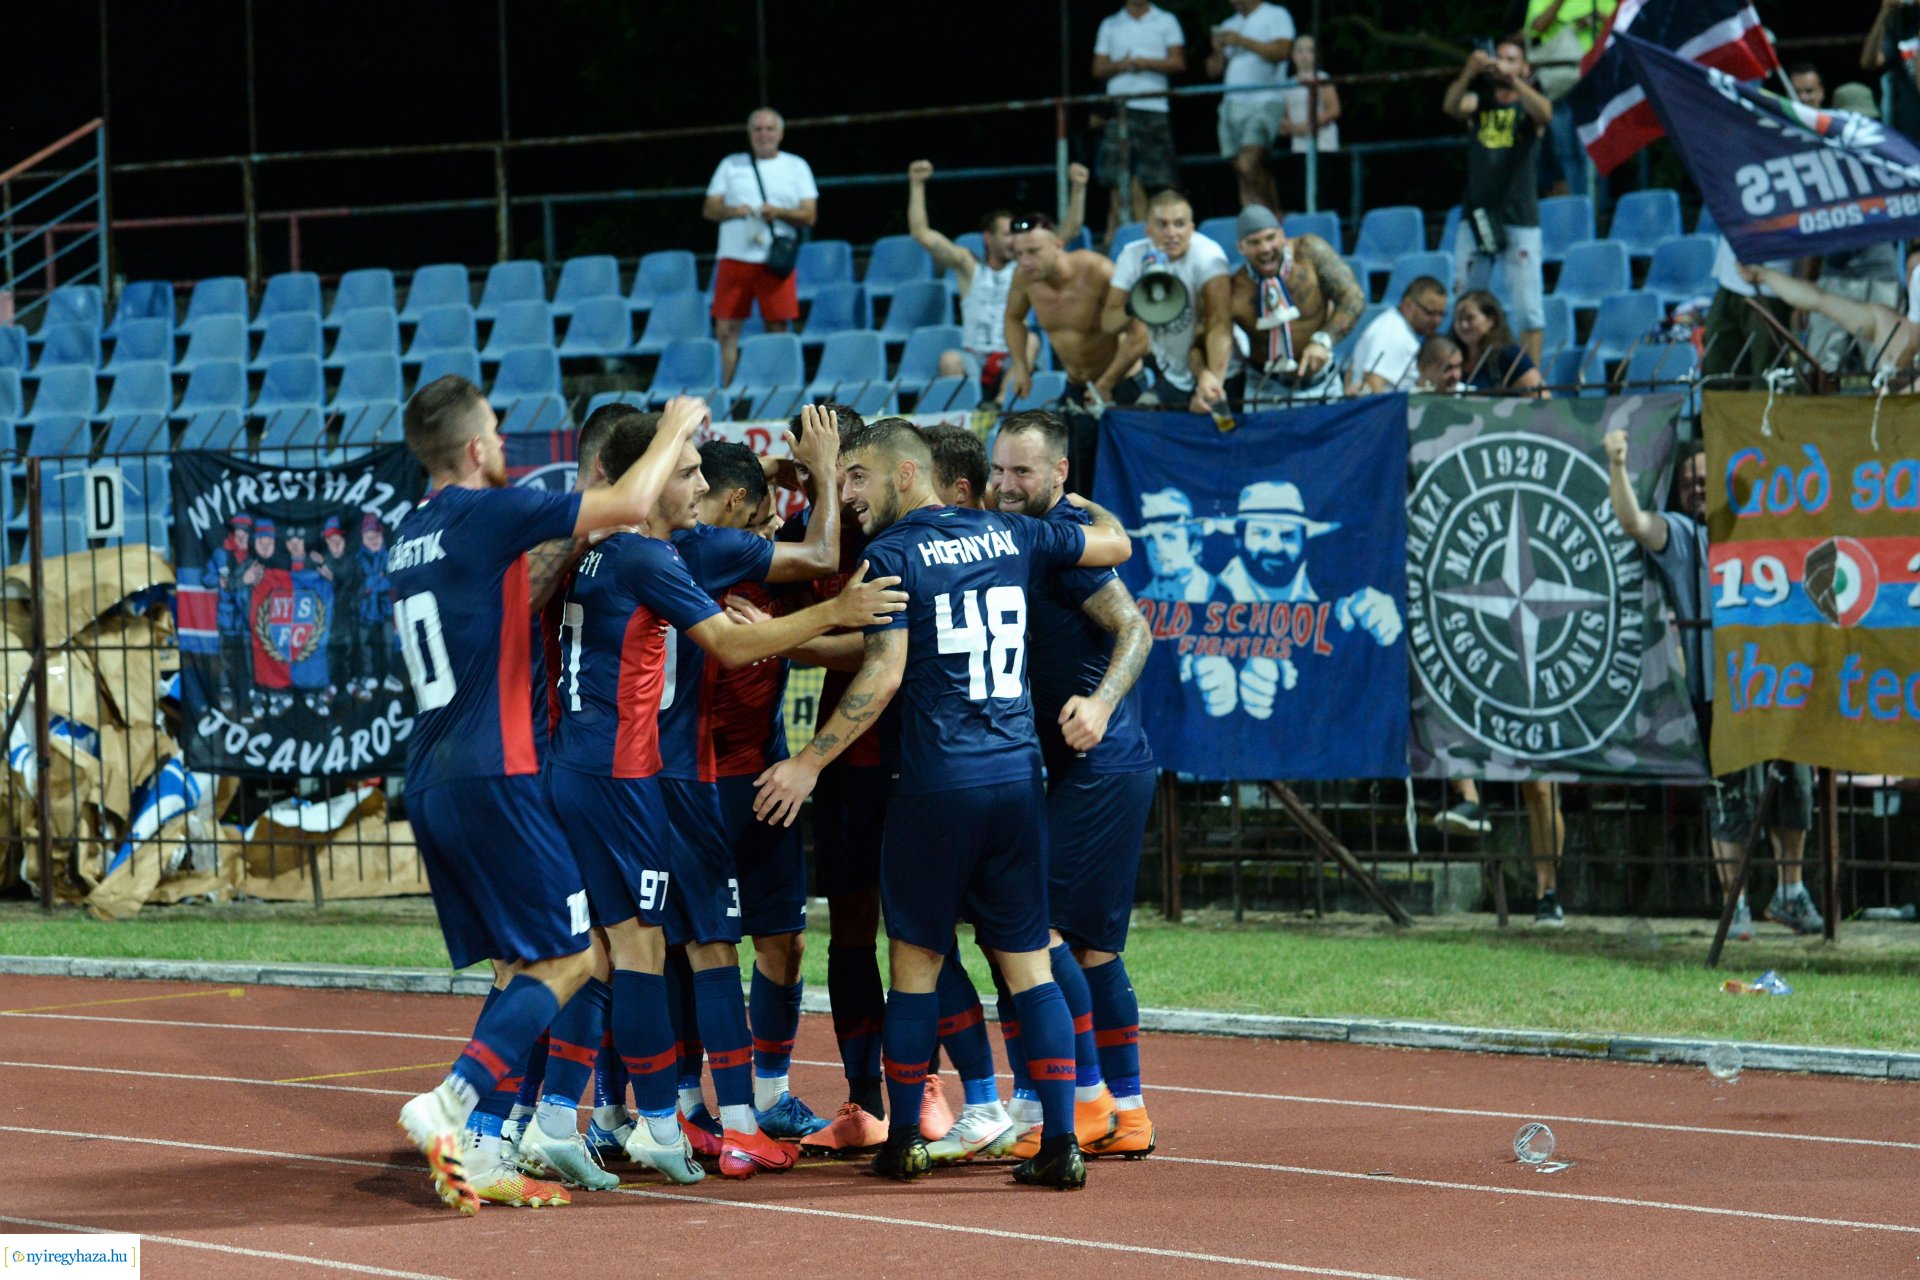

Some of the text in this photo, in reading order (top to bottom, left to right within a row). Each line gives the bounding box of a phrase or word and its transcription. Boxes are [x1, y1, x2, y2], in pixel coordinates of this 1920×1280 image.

[1480, 445, 1549, 480] 1928
[1726, 443, 1832, 518] God
[93, 475, 115, 531] D
[1713, 555, 1790, 608] 19
[935, 586, 1028, 700] 48
[1136, 598, 1334, 656] OLD SCHOOL
[1178, 634, 1294, 660] FIGHTERS
[1726, 642, 1815, 714] the
[639, 869, 669, 911] 97
